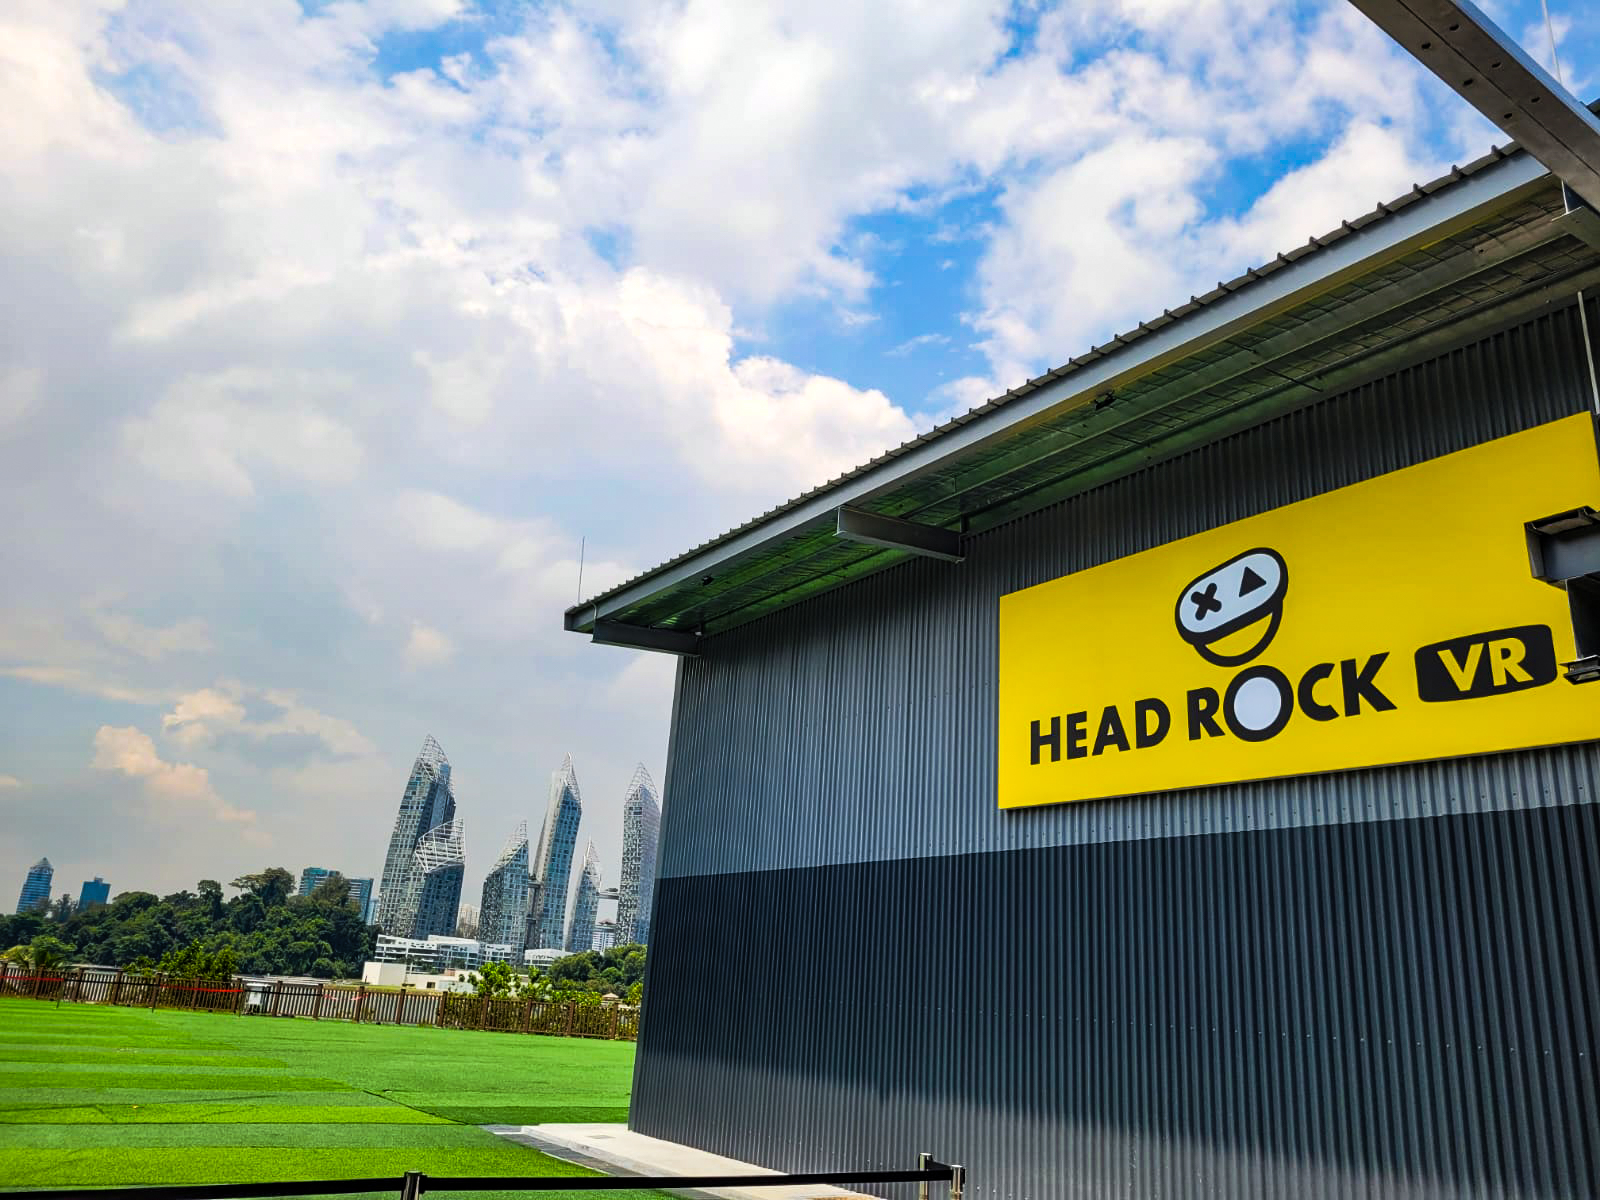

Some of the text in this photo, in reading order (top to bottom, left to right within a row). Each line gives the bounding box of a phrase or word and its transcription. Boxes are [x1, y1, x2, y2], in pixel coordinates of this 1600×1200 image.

[1030, 637, 1534, 765] HEAD ROCK VR
